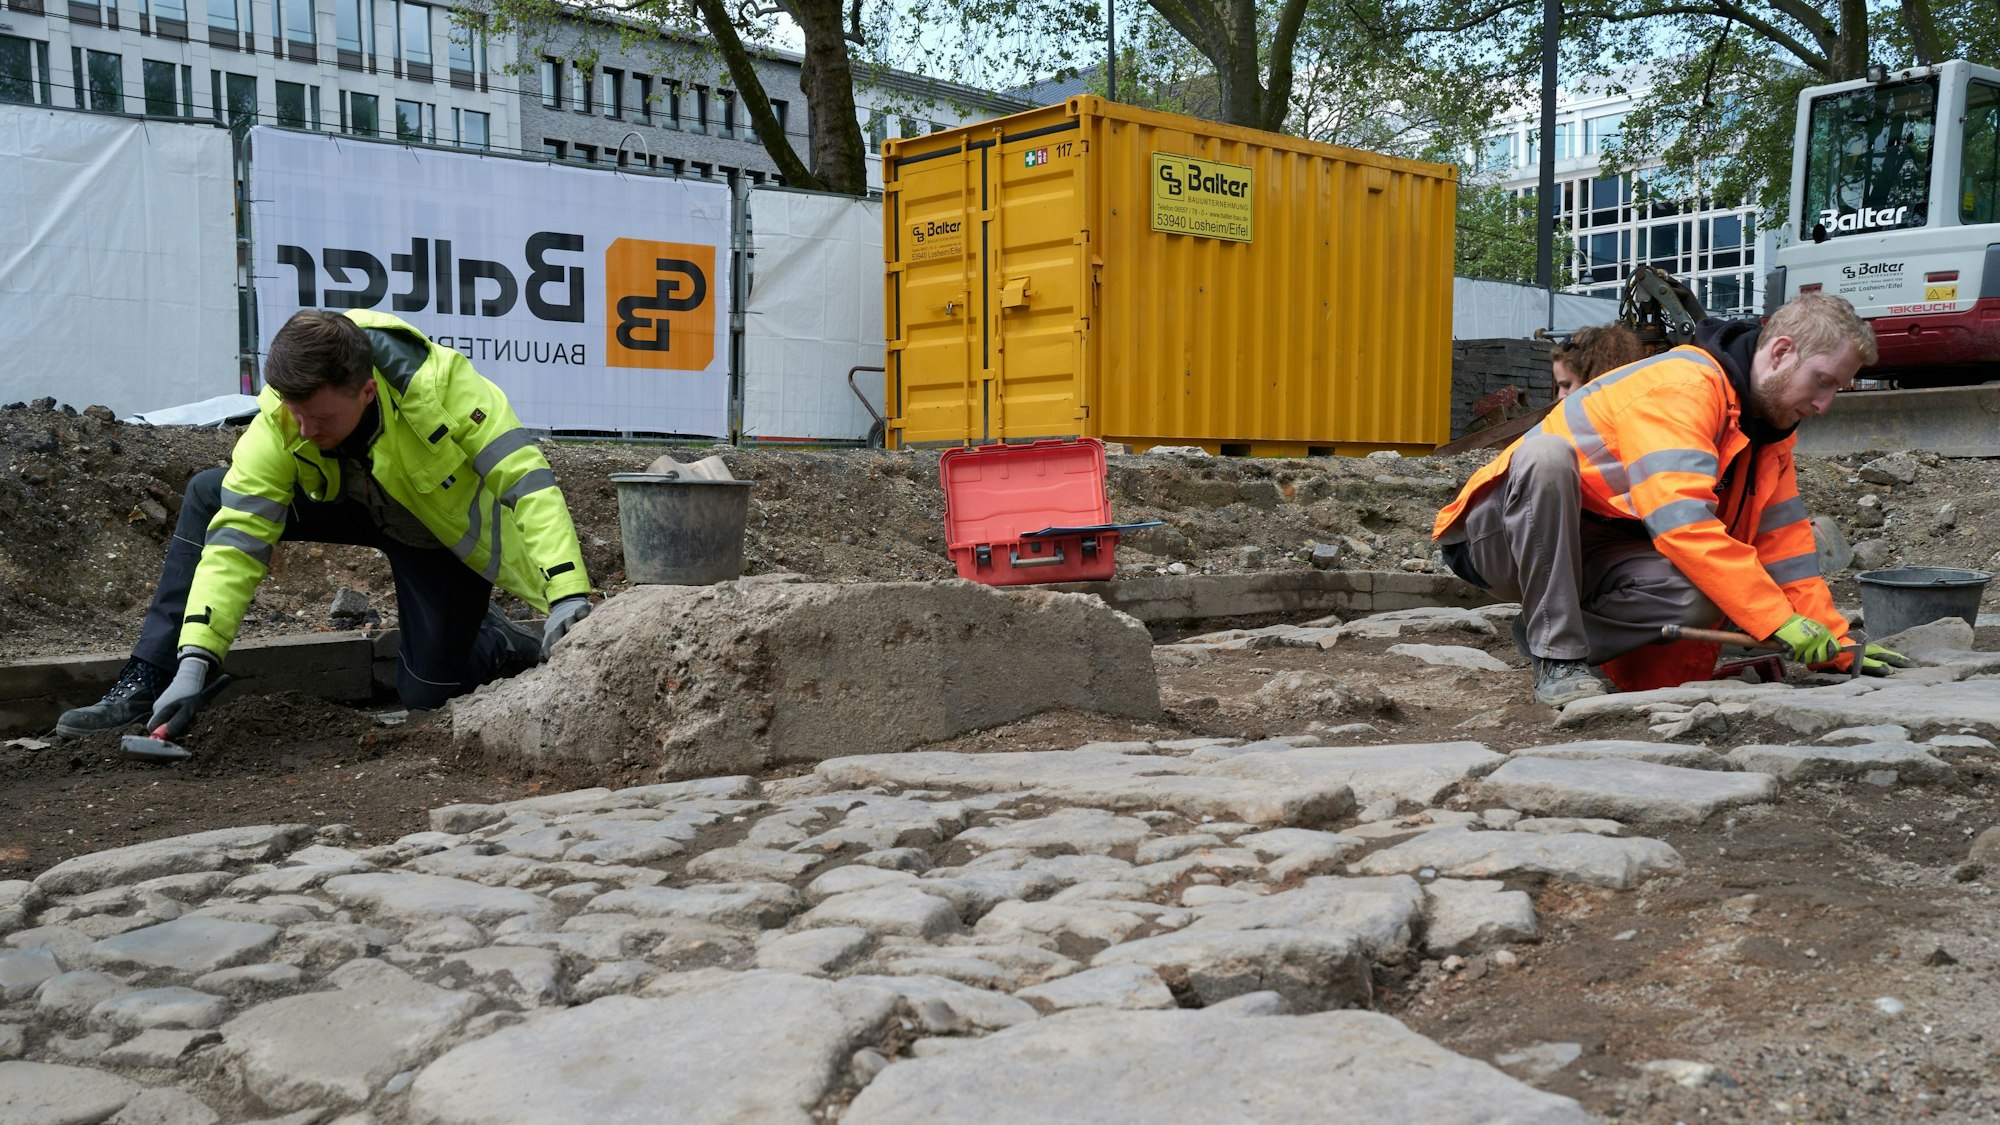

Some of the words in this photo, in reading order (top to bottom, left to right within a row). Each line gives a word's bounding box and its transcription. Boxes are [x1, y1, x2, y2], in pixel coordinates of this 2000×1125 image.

[1056, 143, 1072, 158] 117
[1188, 164, 1248, 198] Balter
[1187, 196, 1248, 211] BAUUNTERNEHMUNG
[1157, 213, 1186, 228] 53940
[1189, 217, 1248, 236] Losheim/Eifel
[1819, 206, 1907, 233] Balter
[928, 222, 961, 236] Balter
[1858, 262, 1904, 275] Balter
[1858, 282, 1903, 292] Losheim/Eifel
